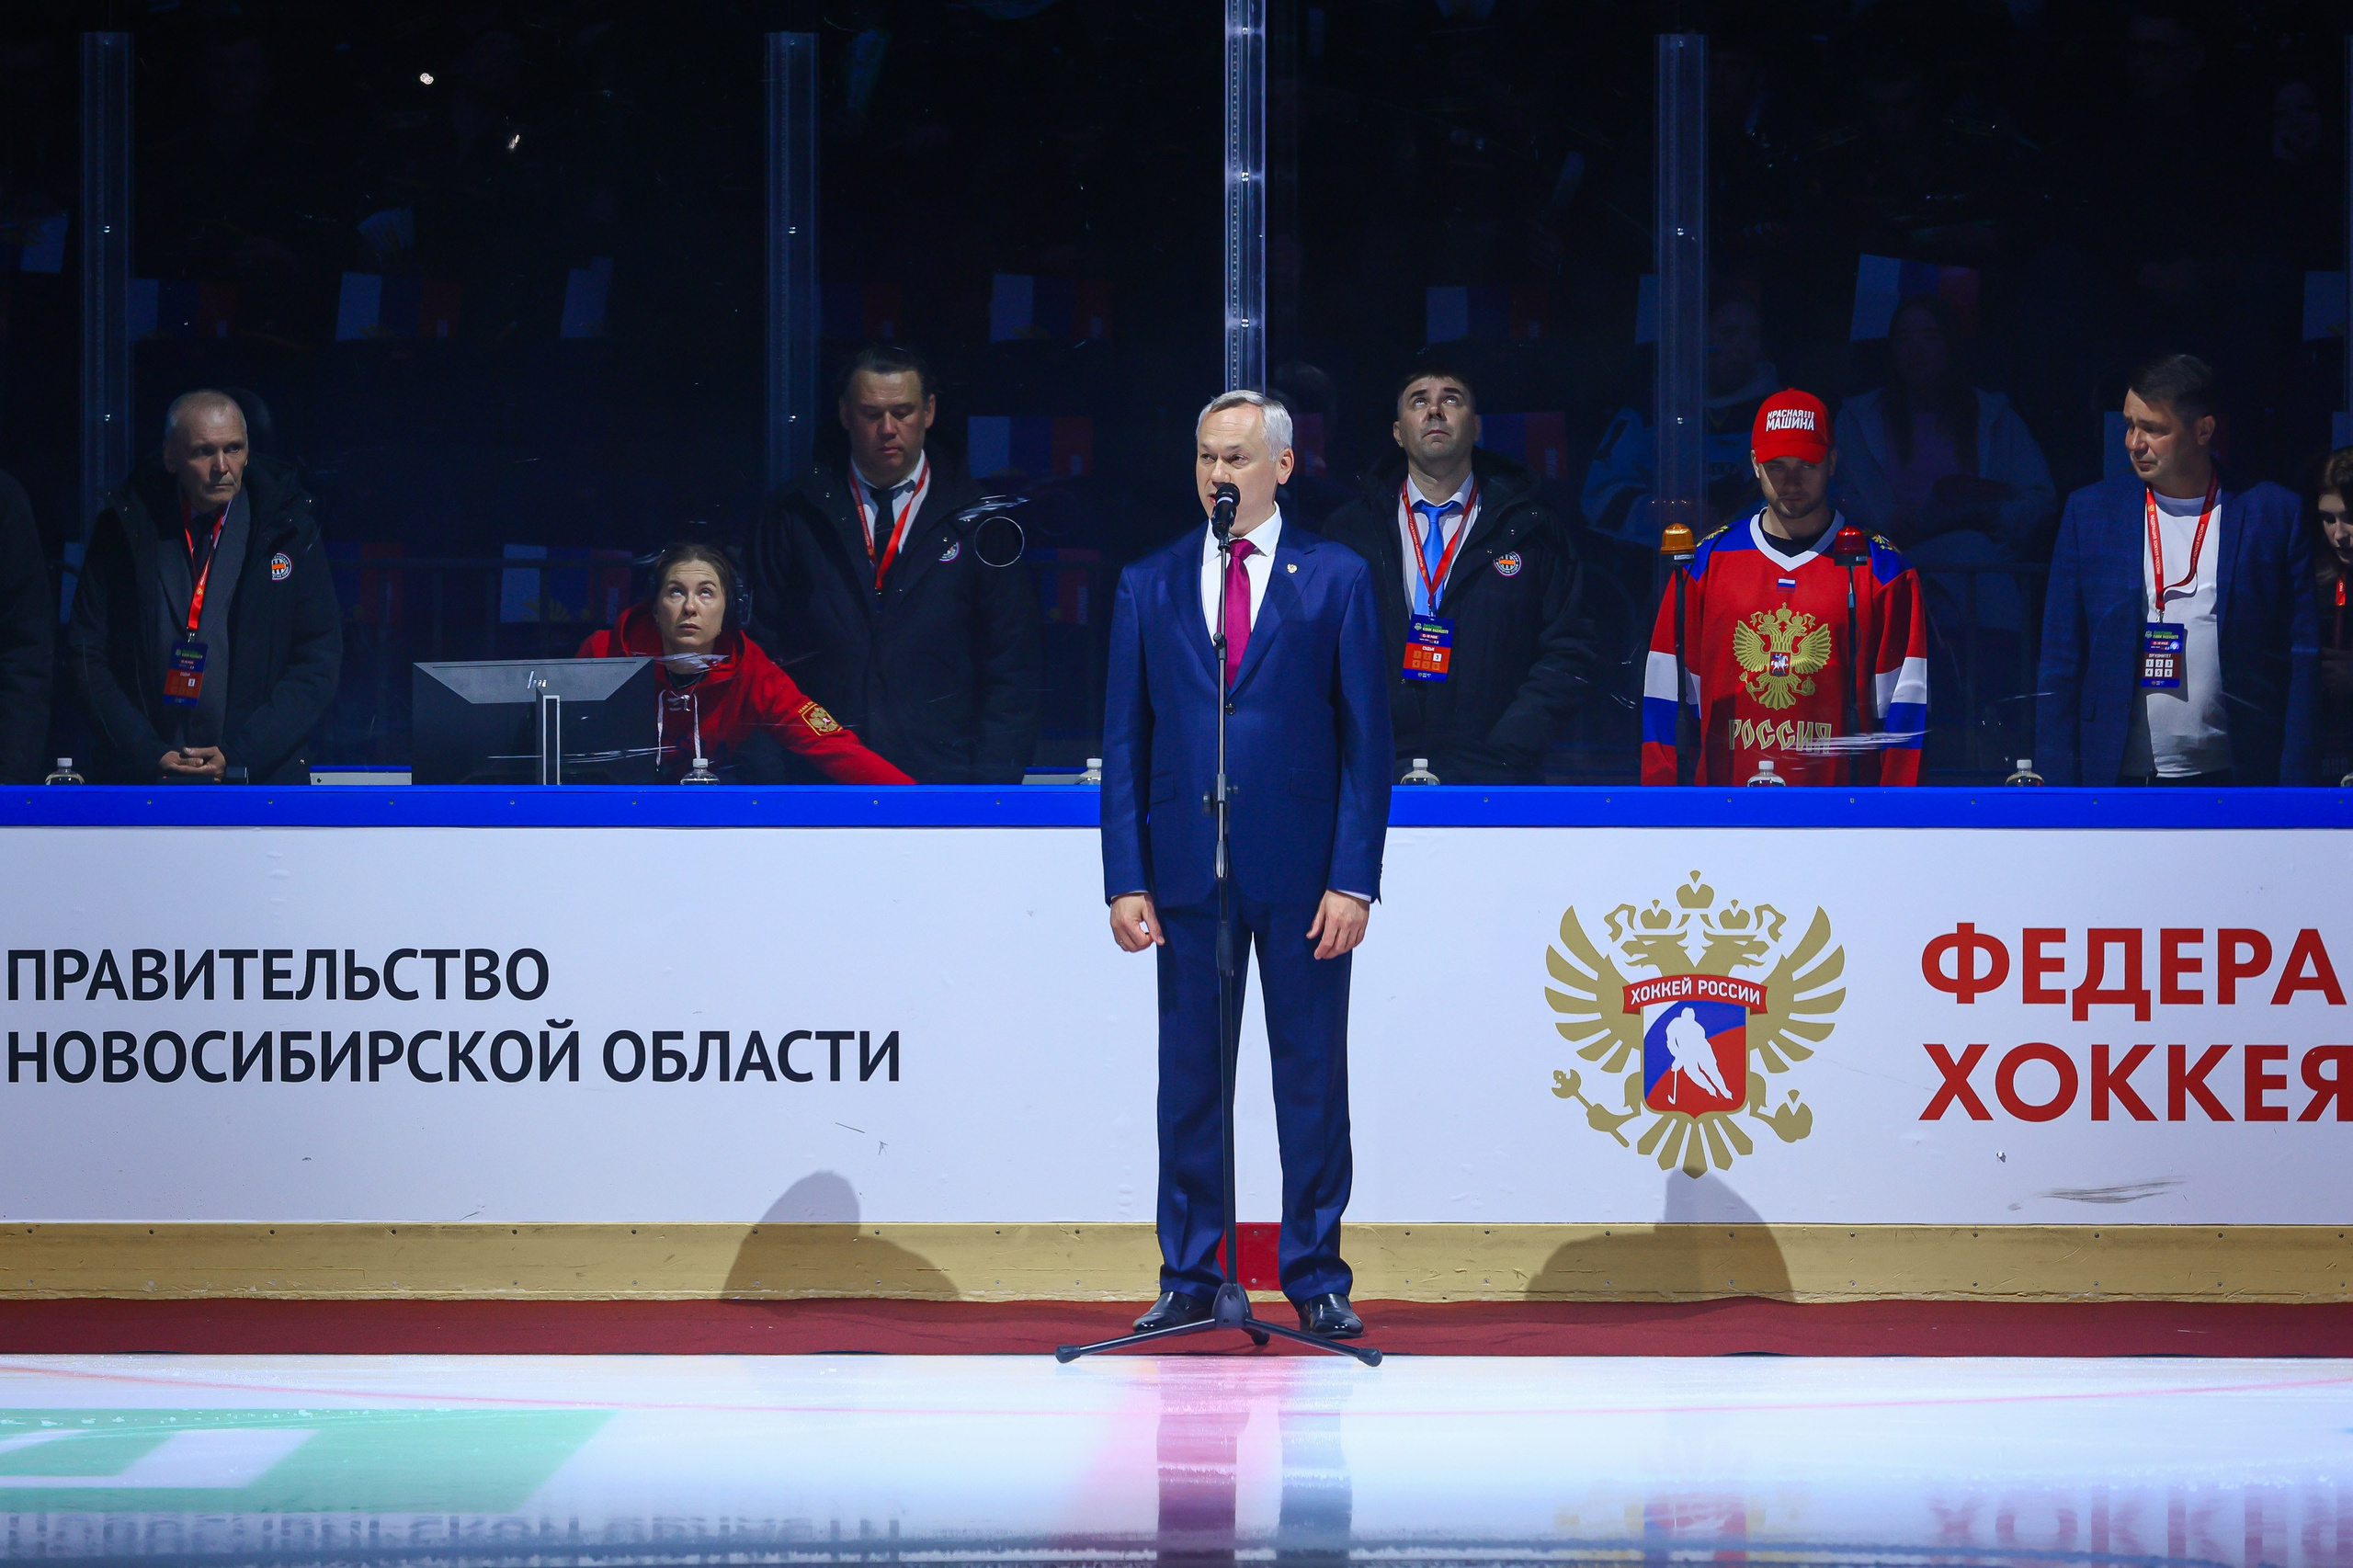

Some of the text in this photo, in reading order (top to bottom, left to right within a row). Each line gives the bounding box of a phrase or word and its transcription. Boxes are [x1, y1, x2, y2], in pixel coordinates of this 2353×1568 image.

[1766, 416, 1815, 432] МАШИНА
[1729, 719, 1832, 754] РОССИЯ
[8, 949, 549, 1001] ПРАВИТЕЛЬСТВО
[1630, 977, 1760, 1006] ХОККЕЙ РОССИИ
[1922, 922, 2347, 1021] ФЕДЕРА
[8, 1018, 900, 1084] НОВОСИБИРСКОЙ ОБЛАСТИ
[1919, 1042, 2353, 1122] ХОККЕЯ
